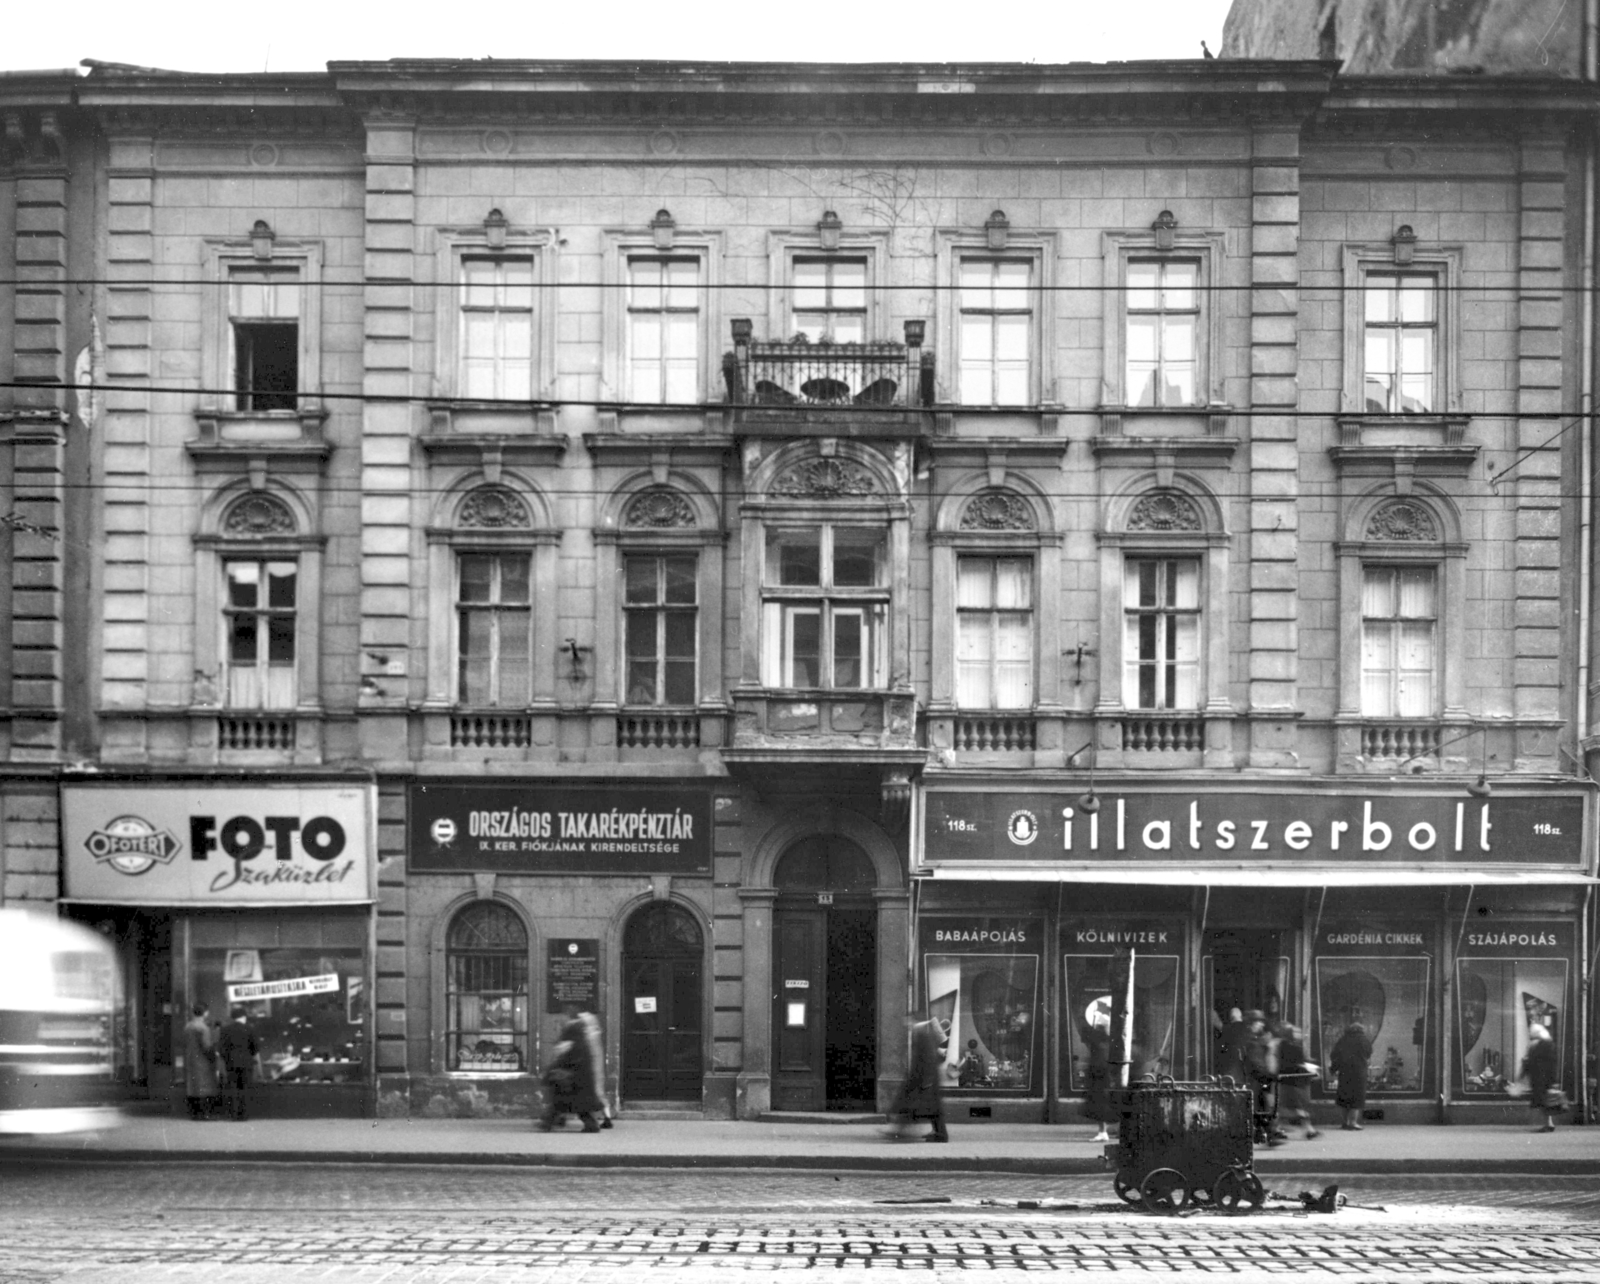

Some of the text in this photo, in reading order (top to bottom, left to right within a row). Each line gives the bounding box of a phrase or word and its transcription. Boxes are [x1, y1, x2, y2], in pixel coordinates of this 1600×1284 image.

[469, 806, 694, 840] ORSZÁGOS TAKARÉKPÉNZTÁR
[947, 819, 966, 832] 118
[1062, 799, 1492, 851] illatszerbolt
[1533, 824, 1552, 835] 118
[189, 815, 347, 862] FOTO
[495, 841, 519, 852] KER.
[521, 839, 586, 852] FIÓKJÁNAK
[591, 841, 680, 853] KIRENDELTSÉGE
[210, 844, 355, 893] Szaküzlet
[935, 927, 1026, 942] BABAÁPOLÁS
[1076, 928, 1168, 943] KÖLNIVIZEK
[1327, 930, 1423, 944] GARDÉNIA CIKKEK
[1468, 931, 1557, 946] SZÁJÁPOLÁS
